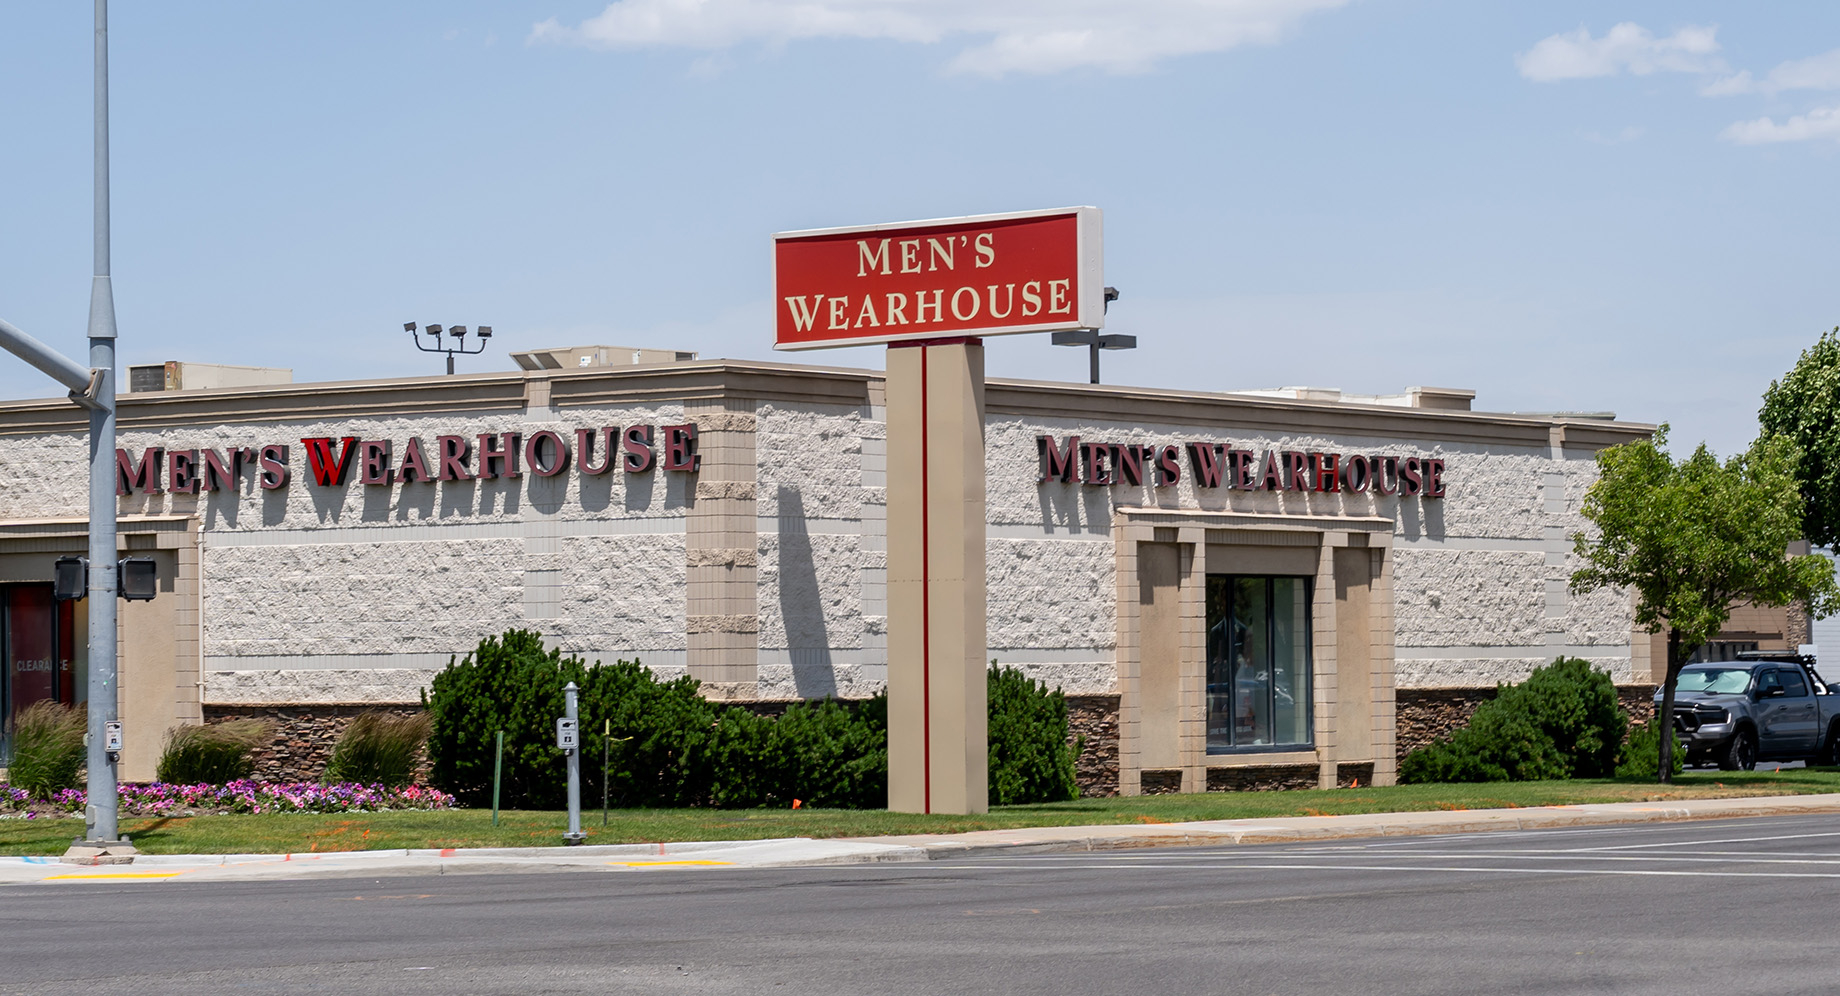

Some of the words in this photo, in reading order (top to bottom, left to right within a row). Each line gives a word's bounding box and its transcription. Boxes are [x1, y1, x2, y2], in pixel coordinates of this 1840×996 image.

[857, 233, 995, 277] MEN'S
[784, 278, 1071, 332] WEARHOUSE
[116, 445, 290, 495] MEN'S
[301, 423, 702, 487] WEARHOUSE
[1037, 435, 1180, 487] MEN'S
[1187, 442, 1446, 498] WEARHOUSE
[16, 659, 69, 671] CLEARAE
